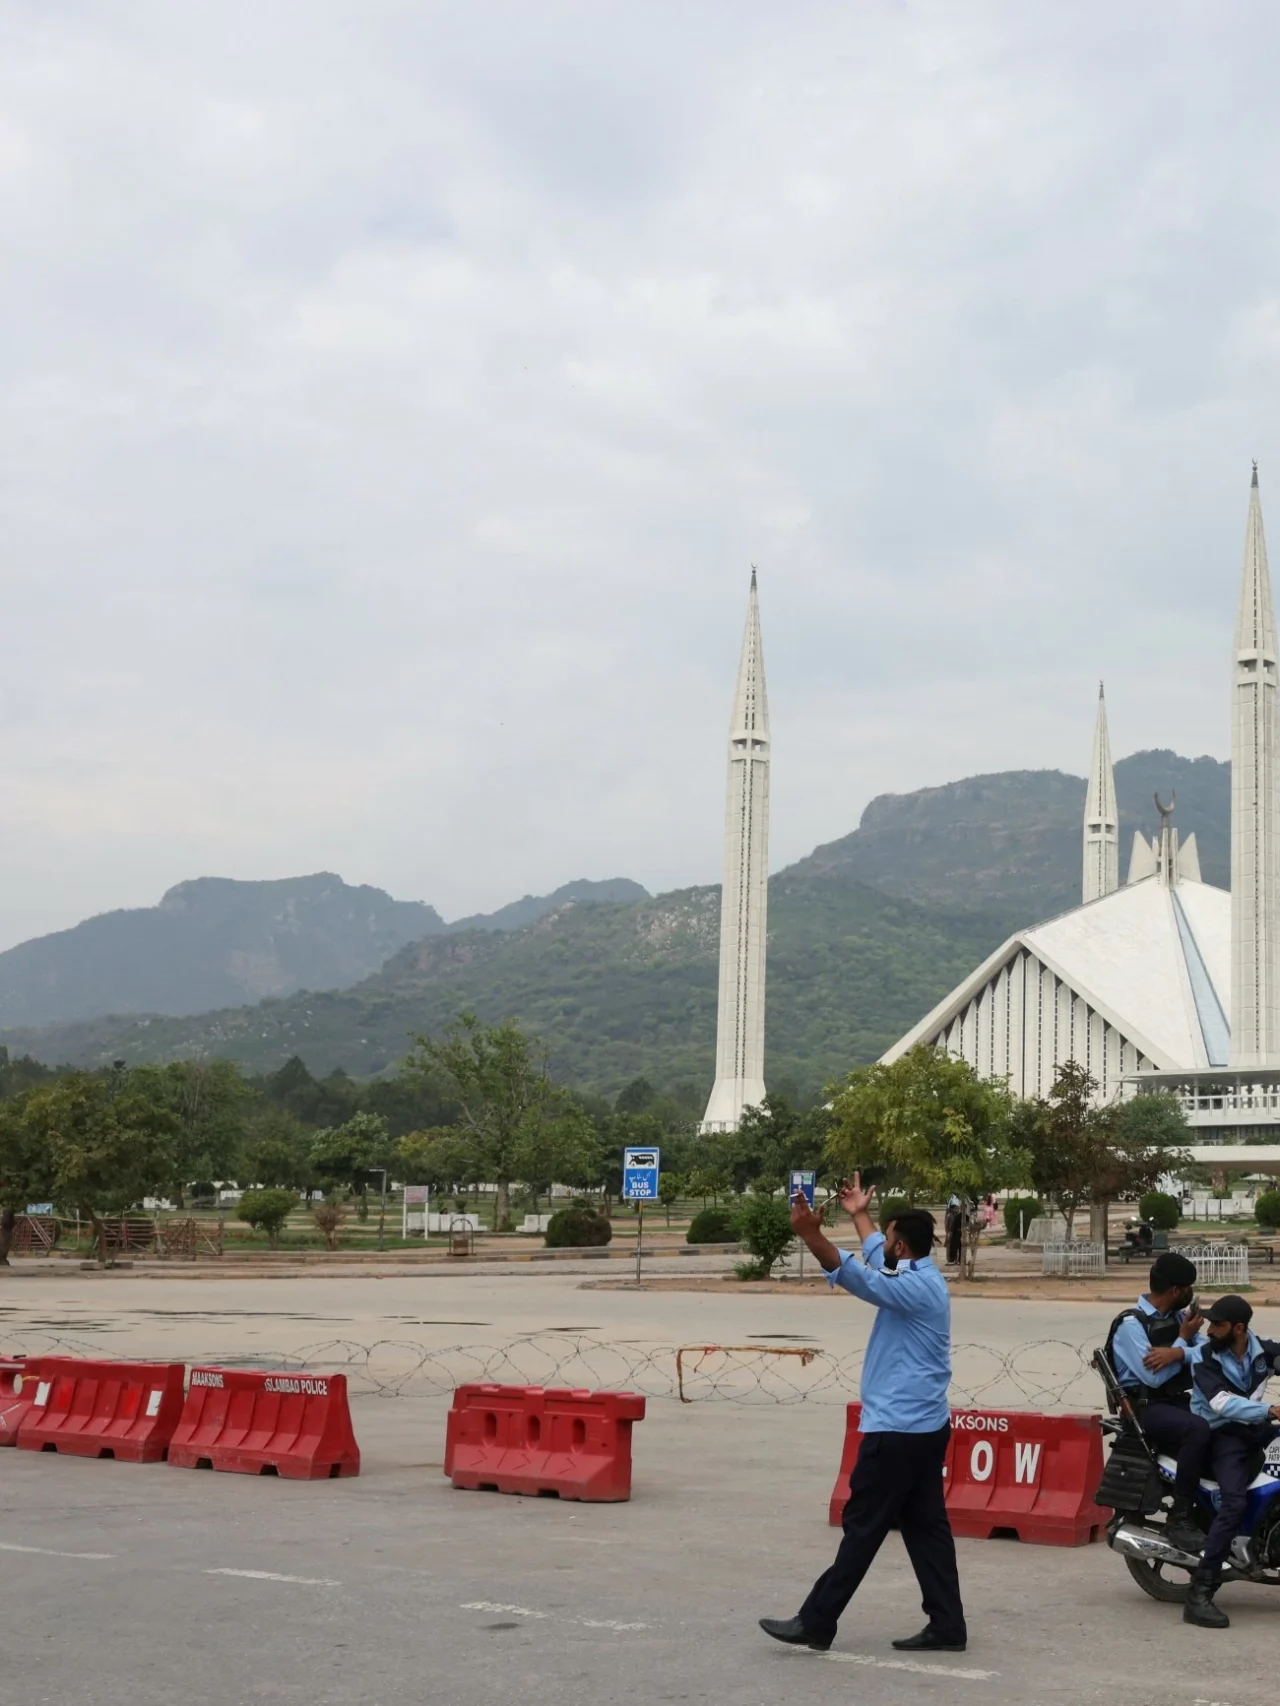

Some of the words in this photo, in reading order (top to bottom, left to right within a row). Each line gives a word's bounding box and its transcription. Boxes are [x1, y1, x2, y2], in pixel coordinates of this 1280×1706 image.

[631, 1181, 649, 1189] BUS
[629, 1189, 652, 1197] STOP
[300, 1379, 328, 1396] POLICE
